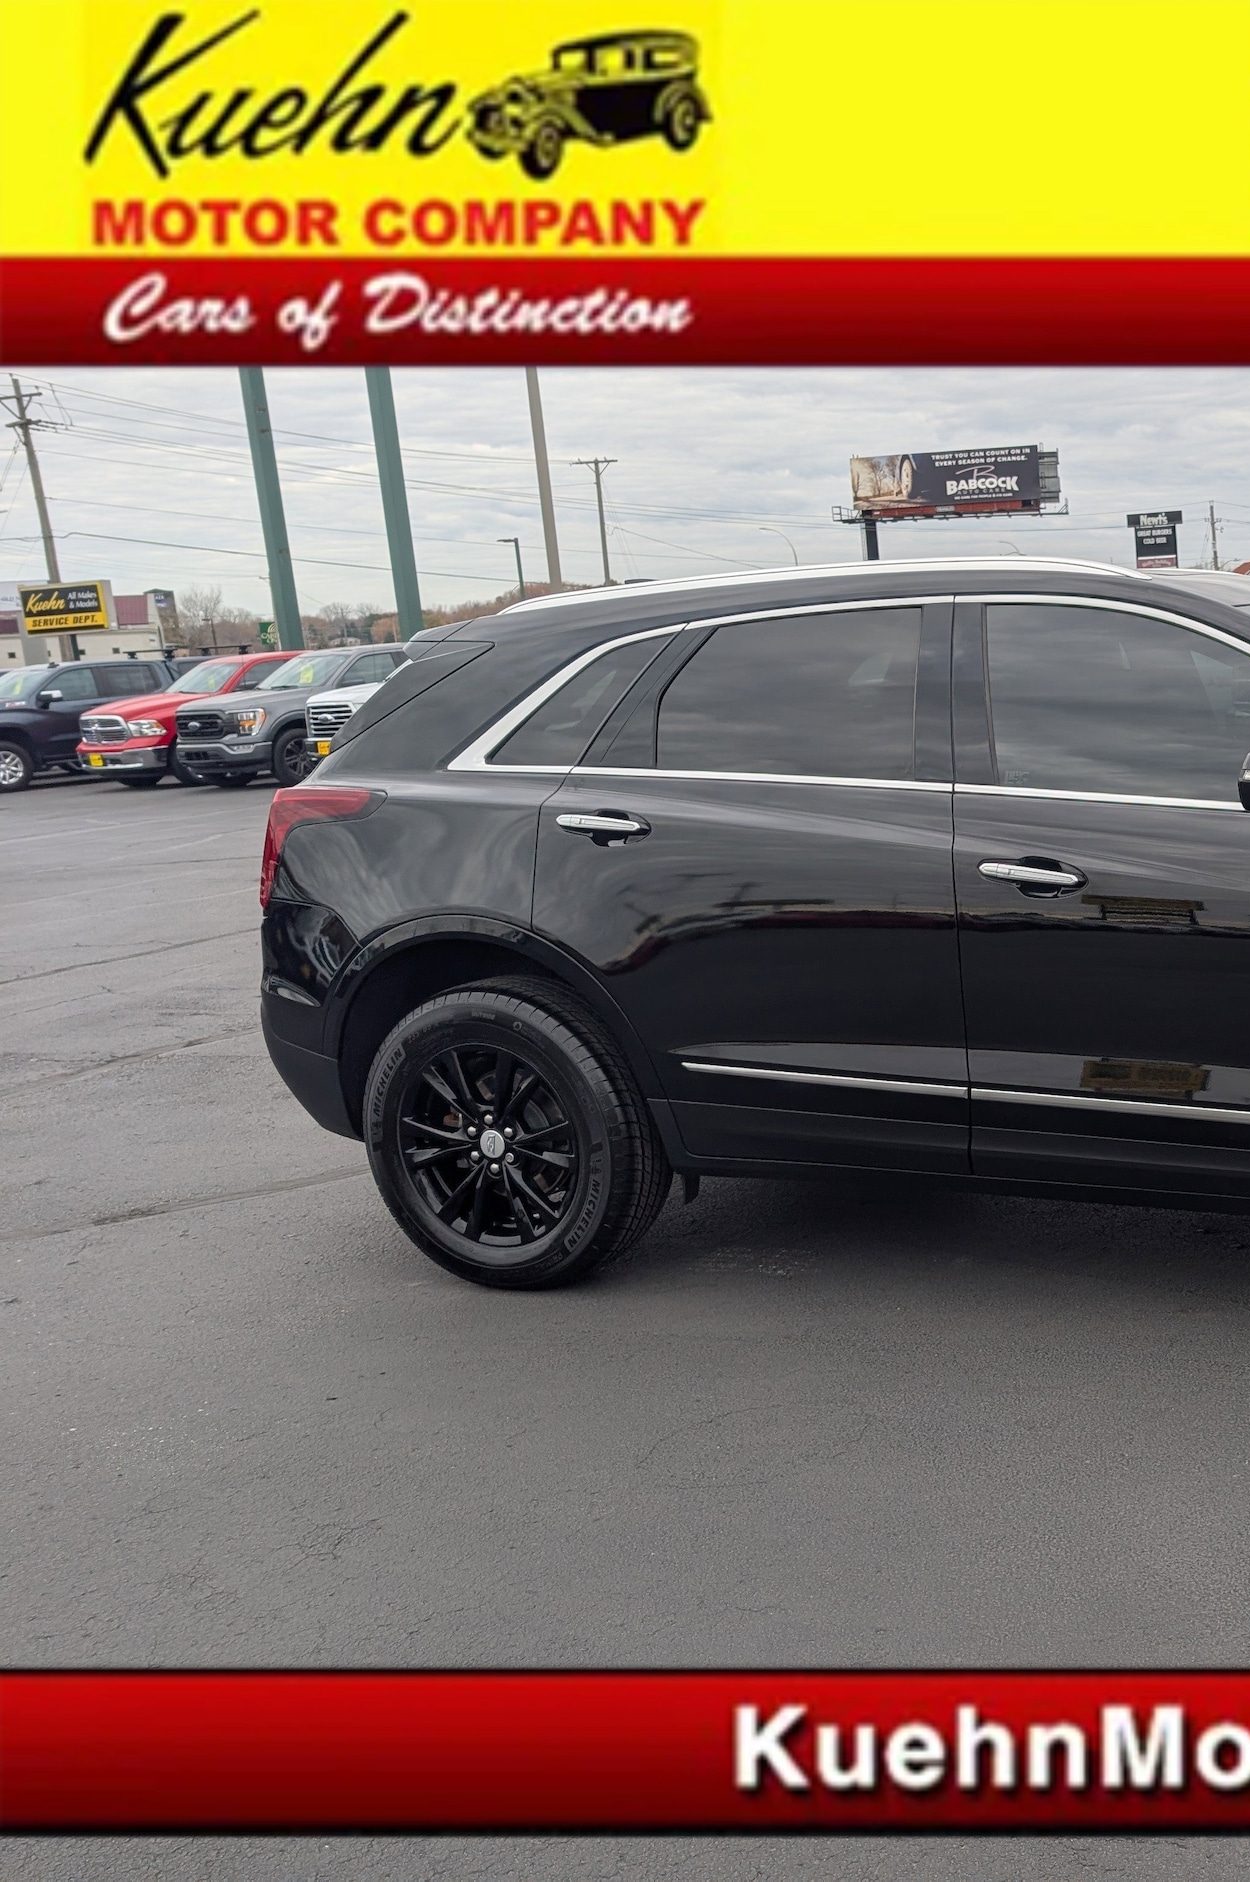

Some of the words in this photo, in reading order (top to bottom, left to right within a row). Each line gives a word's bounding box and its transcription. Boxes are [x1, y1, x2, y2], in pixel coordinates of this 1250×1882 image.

[958, 458, 985, 466] SEASON
[945, 475, 1020, 496] BABCOCK
[1140, 512, 1168, 526] Newt's
[25, 591, 65, 613] Kuehn
[67, 591, 76, 600] All
[77, 590, 97, 599] Makes
[68, 601, 75, 609] &
[76, 599, 98, 608] Models
[31, 616, 69, 628] SERVICE
[72, 614, 98, 624] DEPT.
[373, 1047, 404, 1118] MICHELIN
[567, 1178, 602, 1249] MICHELIN
